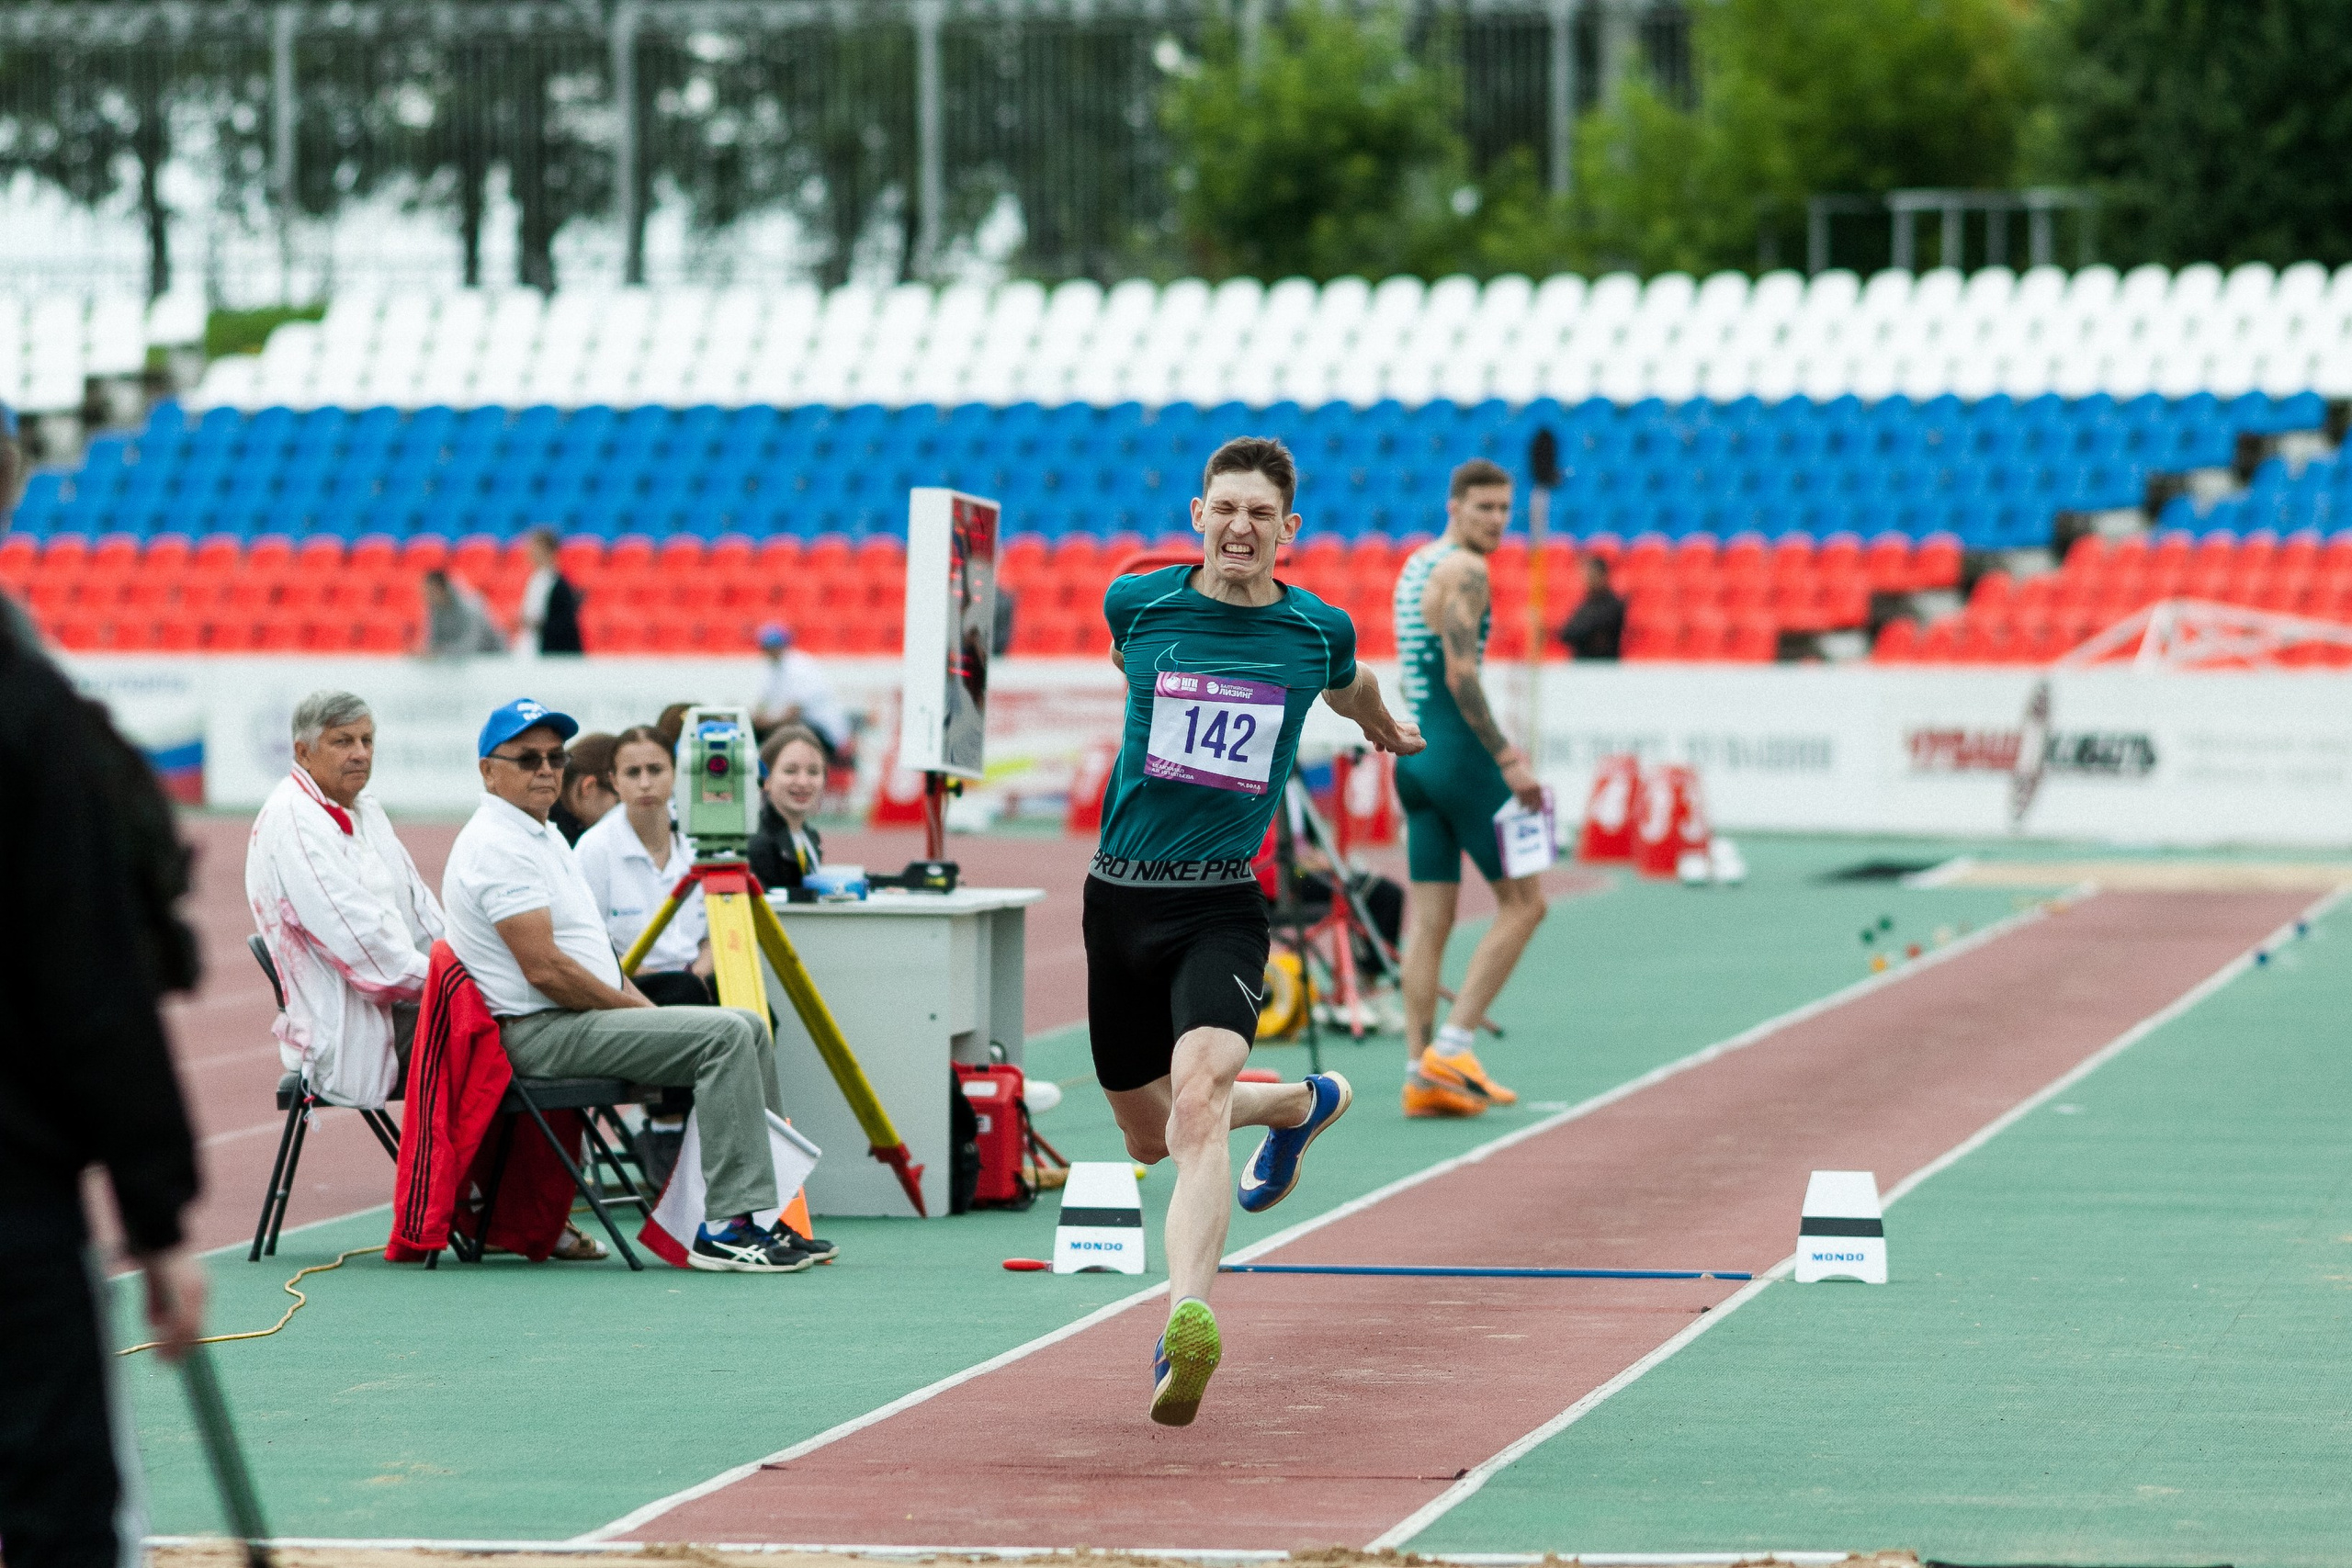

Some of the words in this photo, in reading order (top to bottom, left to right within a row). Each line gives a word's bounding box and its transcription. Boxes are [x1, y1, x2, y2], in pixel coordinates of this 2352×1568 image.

[1219, 689, 1253, 699] ЛИЗИНГ
[1184, 706, 1257, 762] 142
[1094, 849, 1129, 878] PRO
[1131, 860, 1199, 881] NIKE
[1200, 857, 1251, 881] PRO
[1070, 1242, 1123, 1250] MONDO
[1812, 1252, 1864, 1261] MONDO
